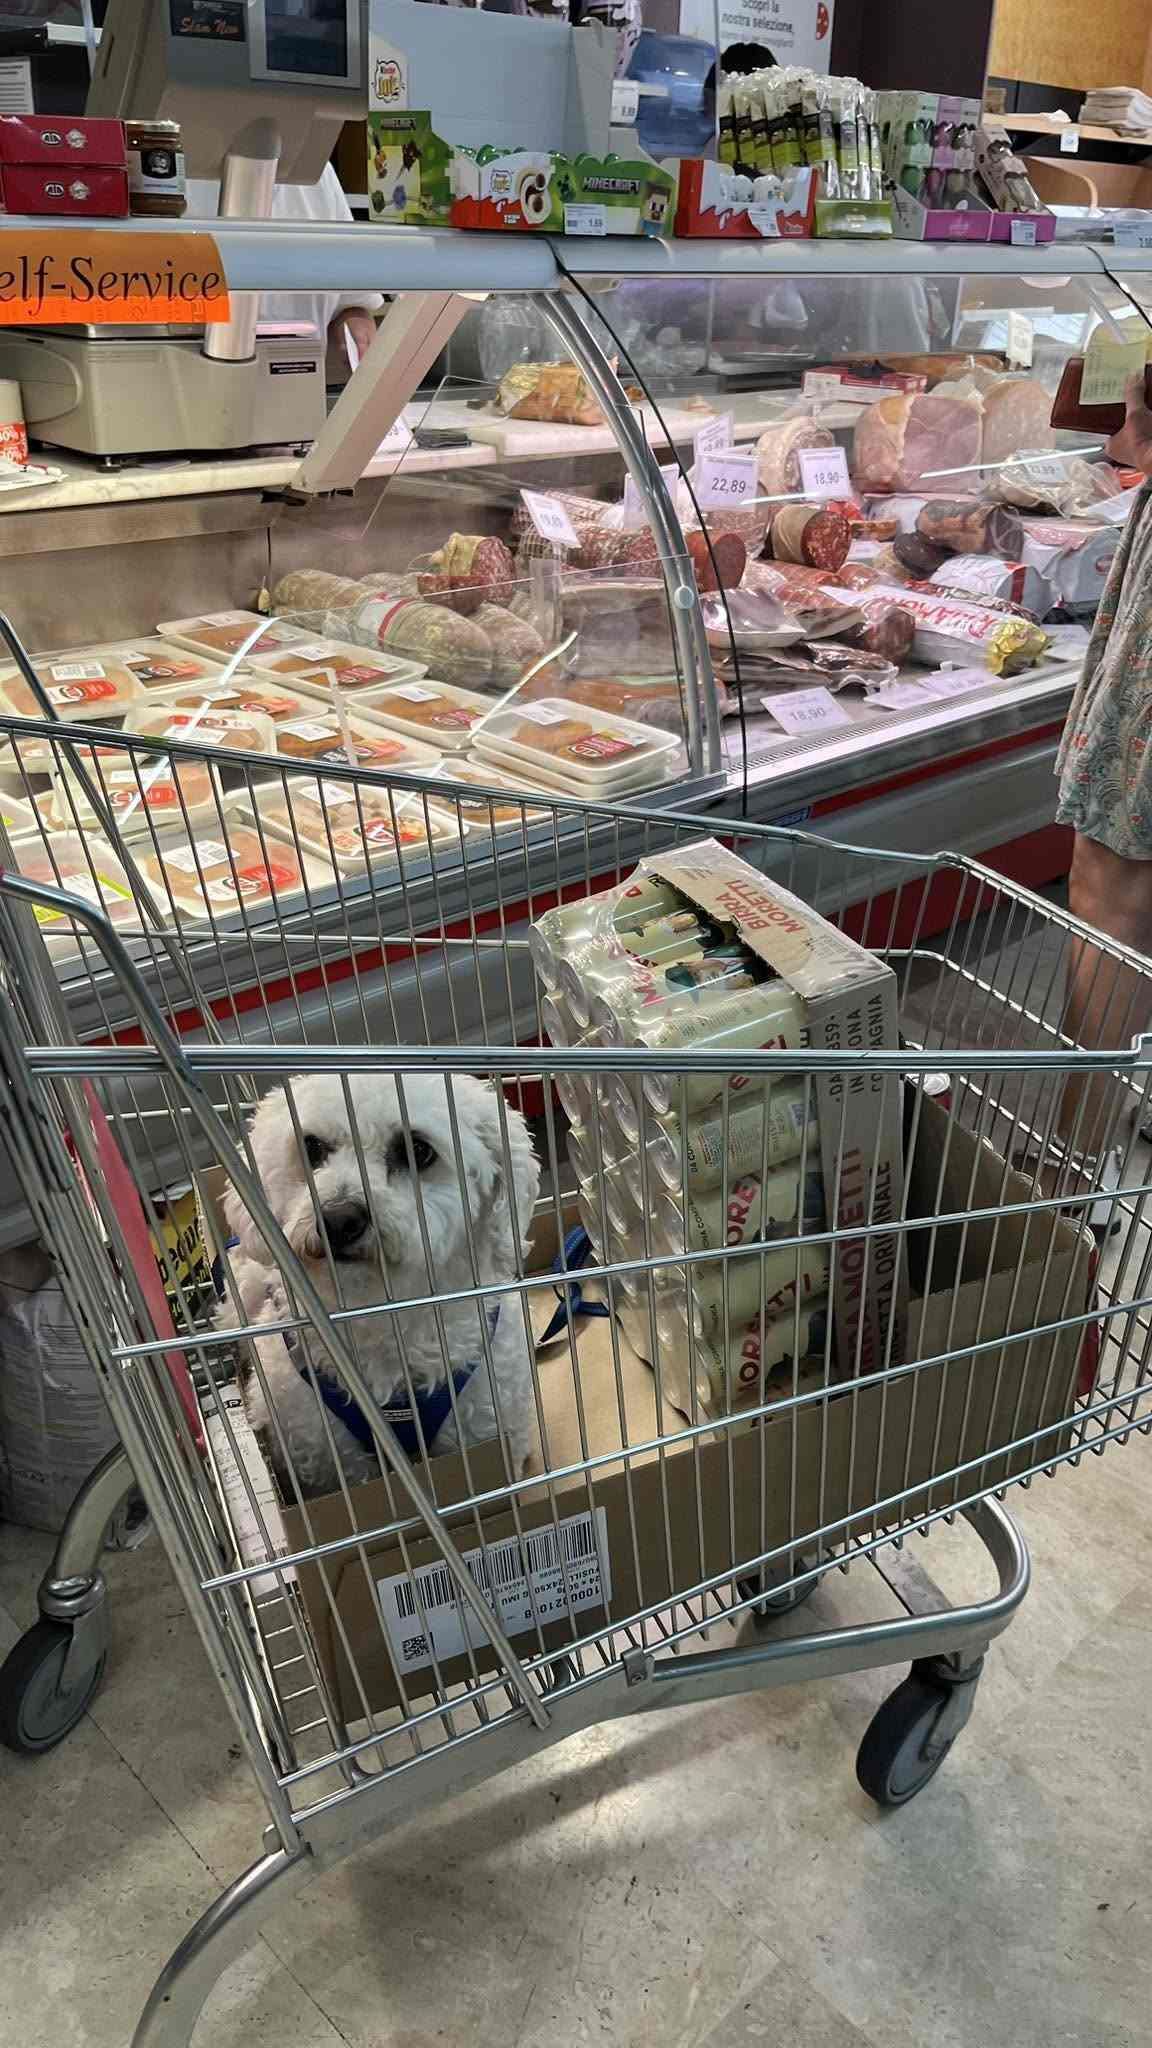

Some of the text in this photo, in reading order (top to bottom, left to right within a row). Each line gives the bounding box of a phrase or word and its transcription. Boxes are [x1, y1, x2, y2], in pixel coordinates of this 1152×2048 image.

[711, 477, 746, 494] 22,89
[790, 706, 826, 722] 18,90
[715, 892, 771, 930] BIRRA
[725, 879, 805, 933] MORETTI
[867, 993, 884, 1093] COAGNIA
